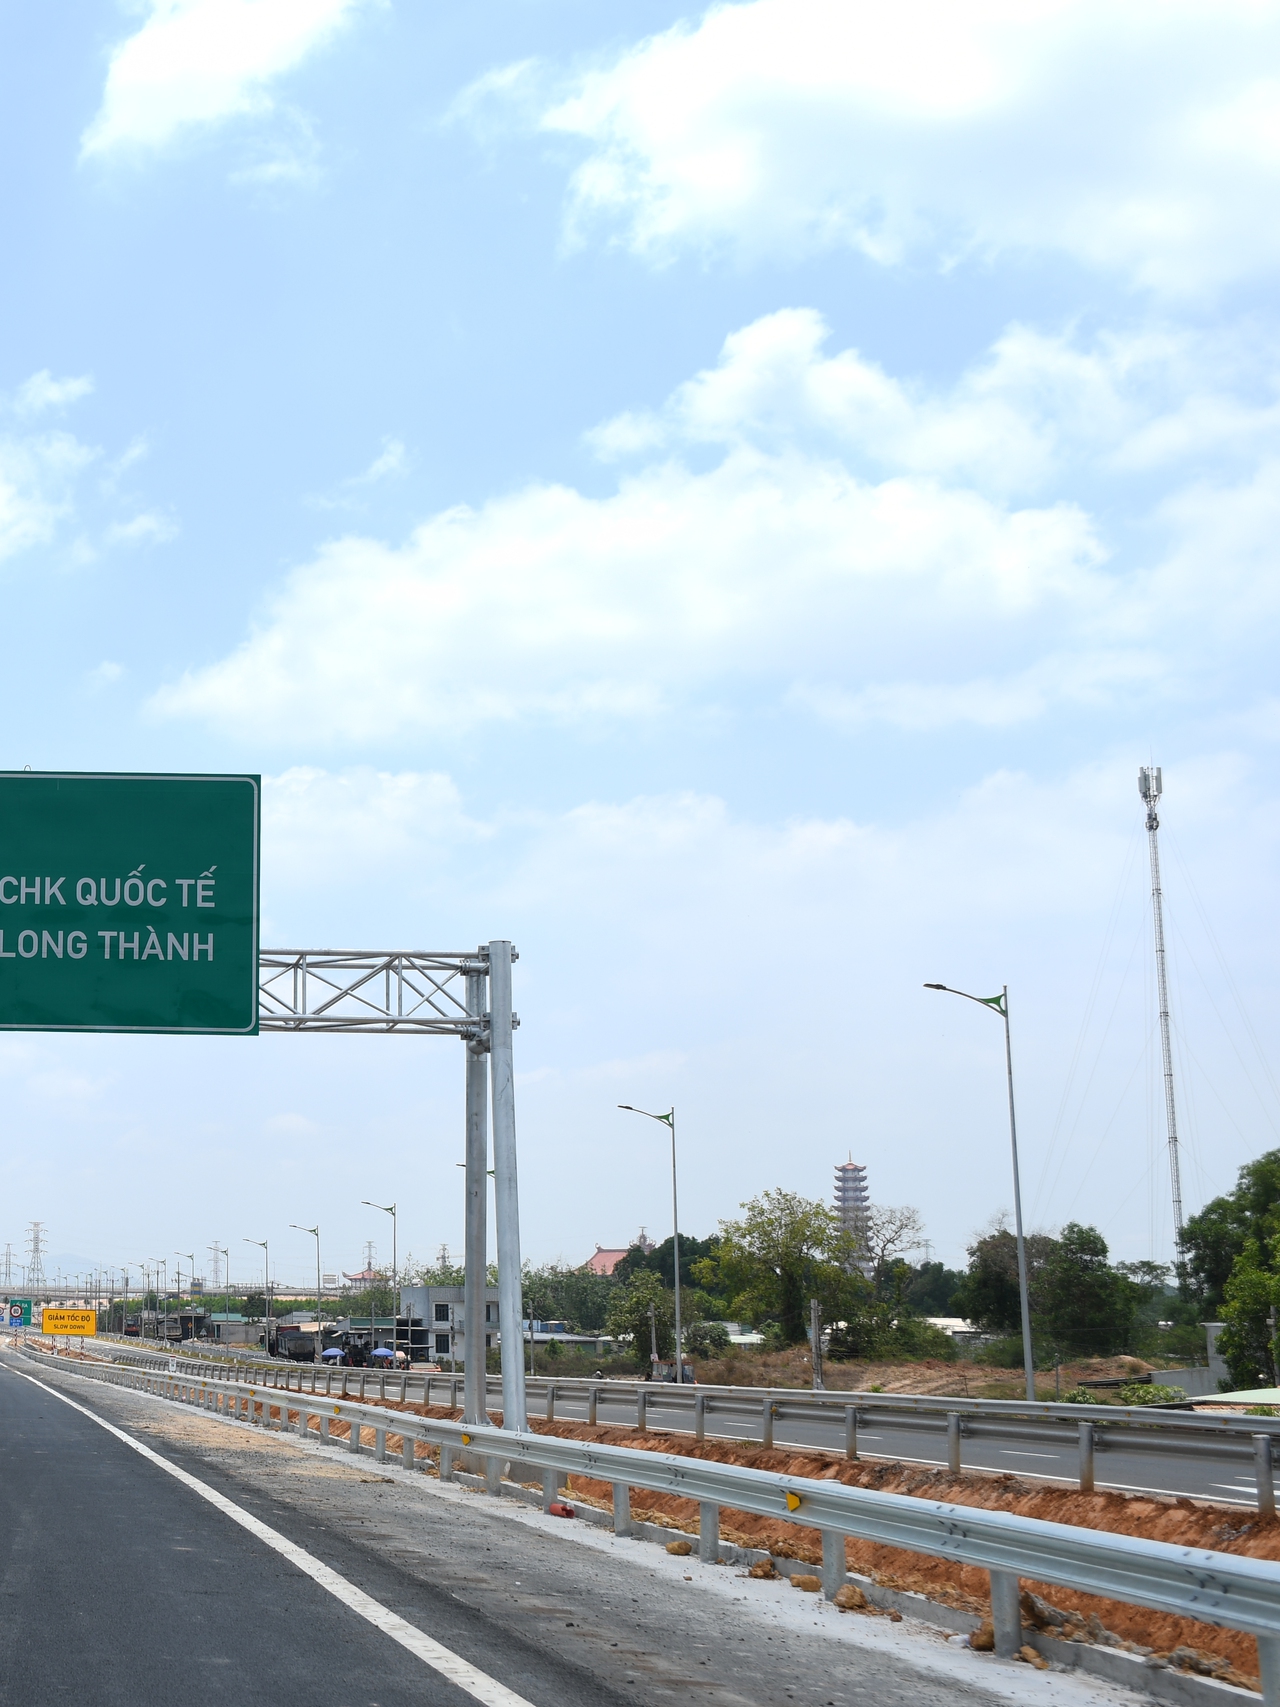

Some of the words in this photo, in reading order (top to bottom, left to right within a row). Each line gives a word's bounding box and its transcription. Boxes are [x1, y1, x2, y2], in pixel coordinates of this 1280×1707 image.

[76, 865, 167, 907] QUỐC
[175, 865, 218, 908] TẾ
[97, 925, 214, 962] THÀNH
[48, 1313, 65, 1321] GIẢM
[67, 1313, 80, 1321] TỐC
